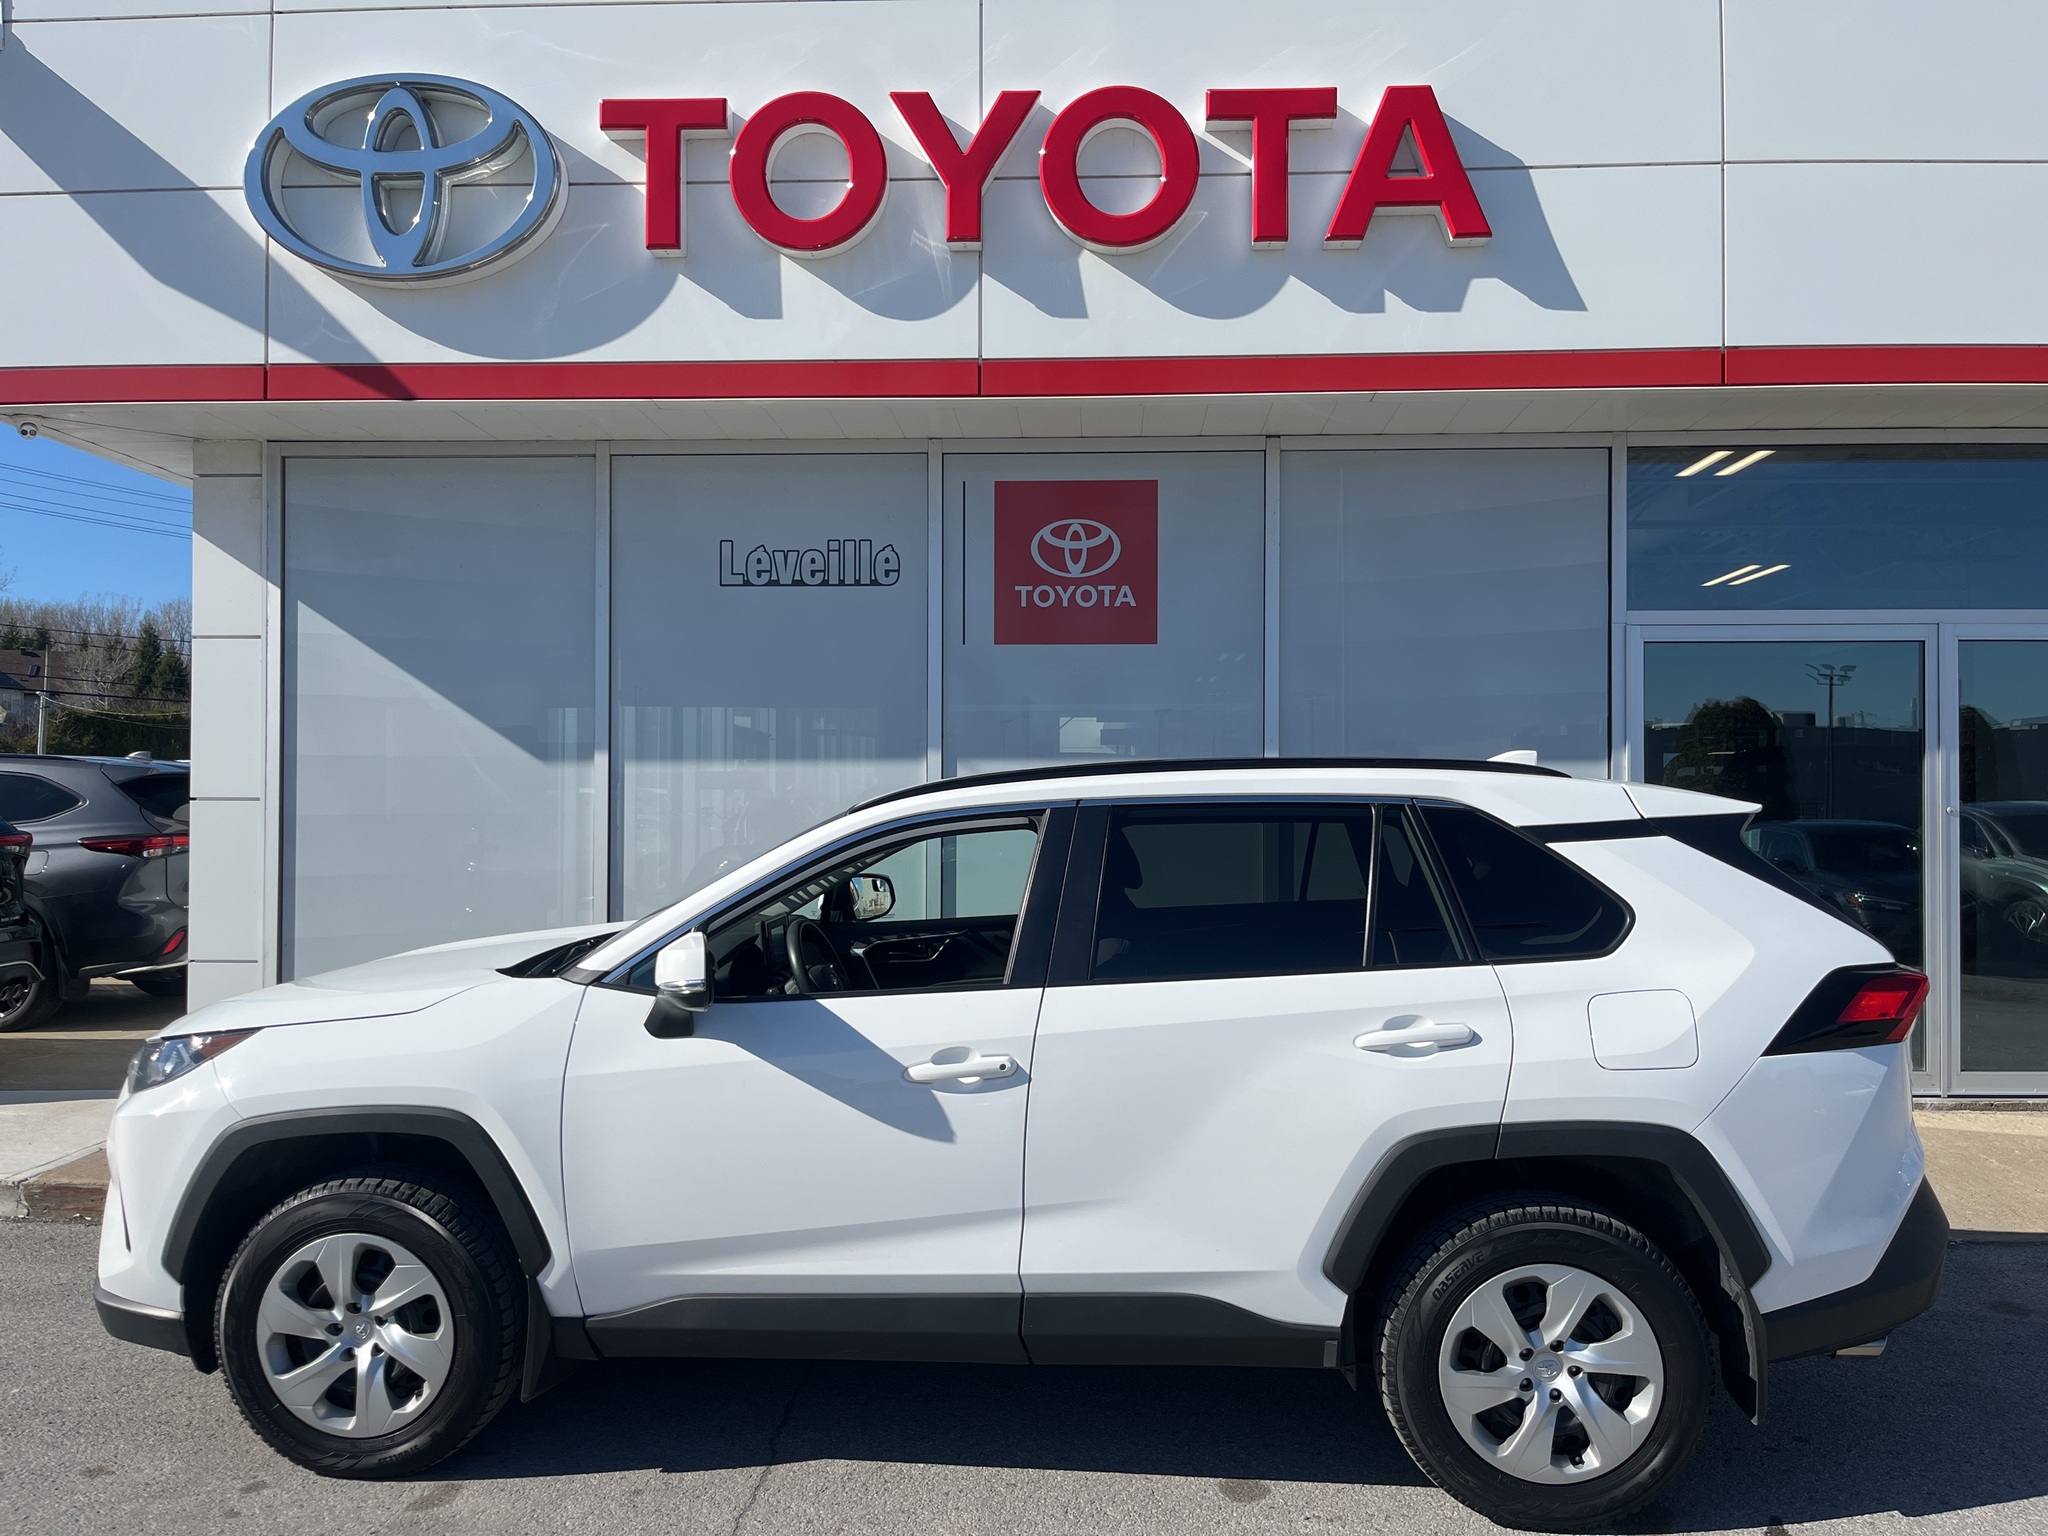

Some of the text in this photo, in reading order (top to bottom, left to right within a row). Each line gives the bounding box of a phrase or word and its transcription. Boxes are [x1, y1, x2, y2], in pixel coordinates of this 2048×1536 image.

[600, 85, 1493, 257] TOYOTA
[719, 538, 900, 586] Léveillé
[1014, 584, 1138, 608] TOYOTA
[1432, 1250, 1484, 1301] OBSERVE
